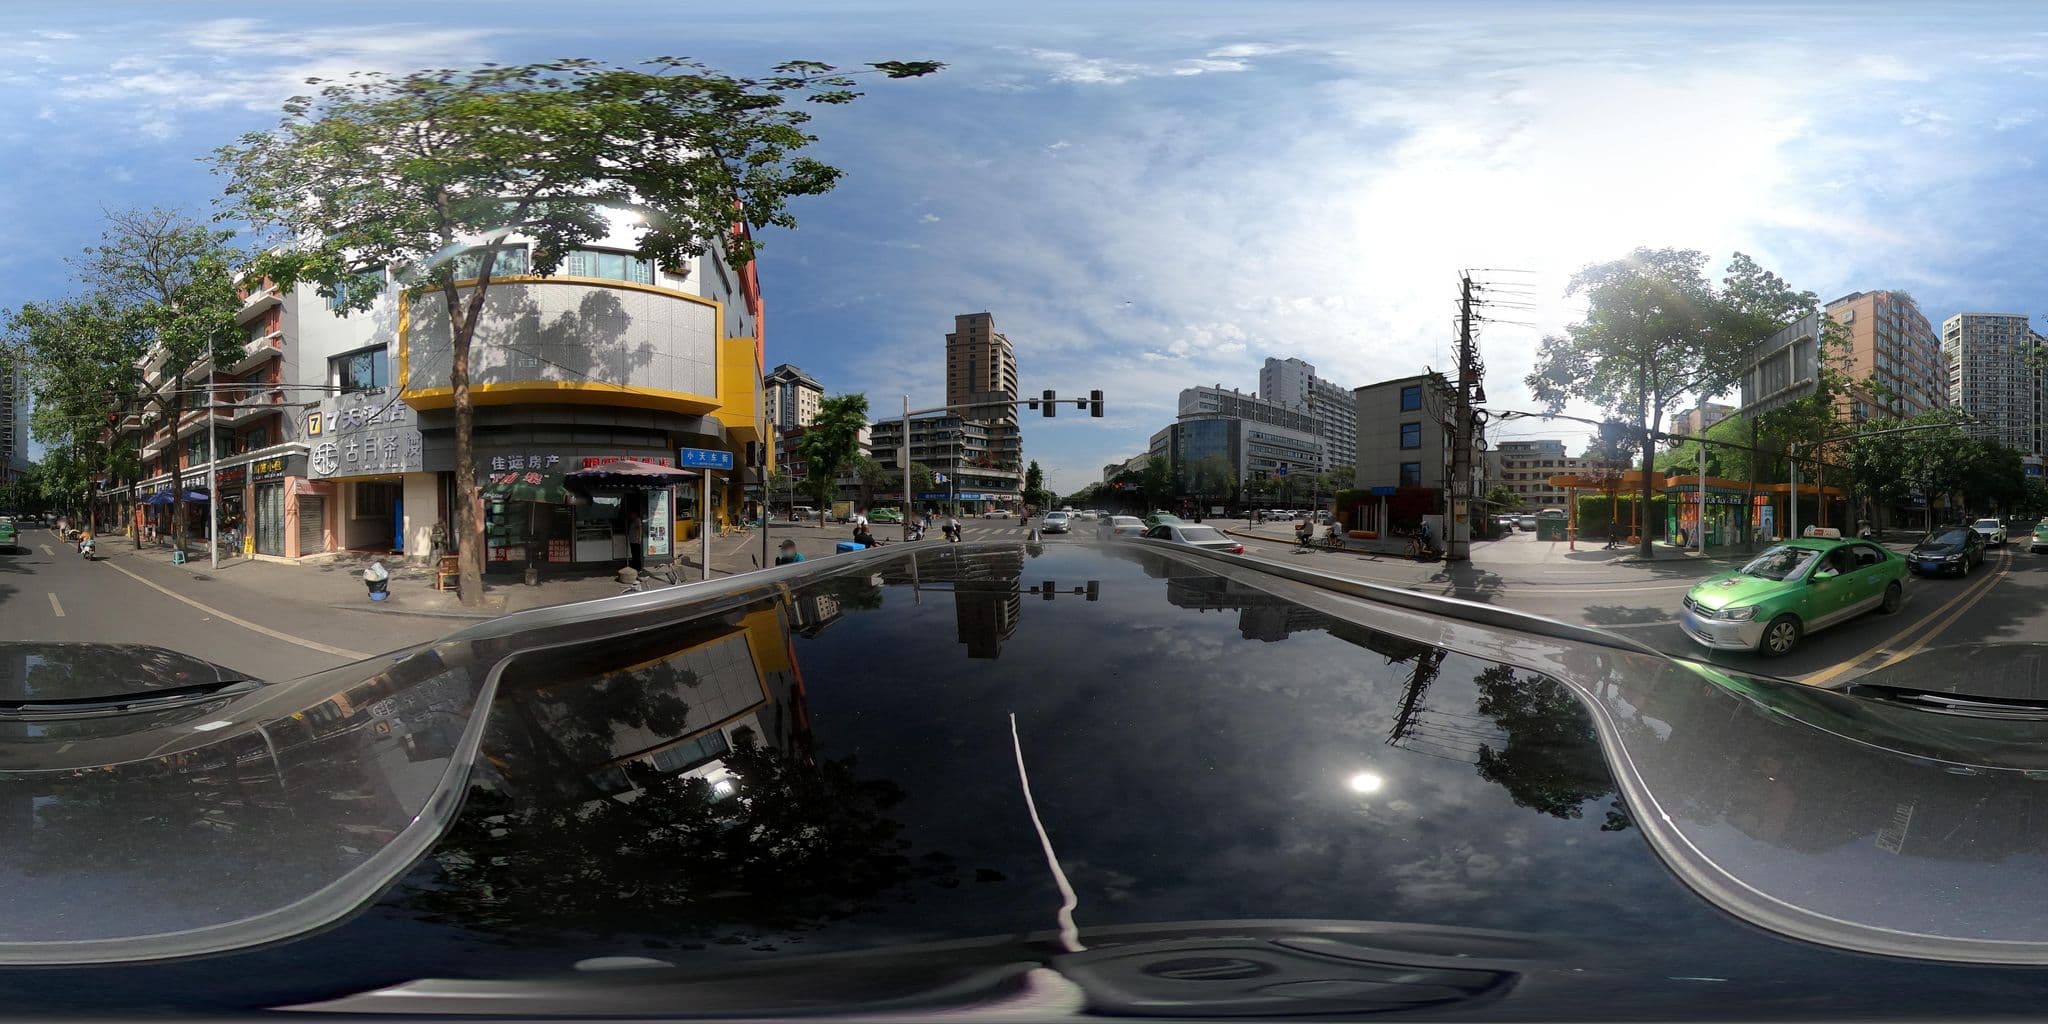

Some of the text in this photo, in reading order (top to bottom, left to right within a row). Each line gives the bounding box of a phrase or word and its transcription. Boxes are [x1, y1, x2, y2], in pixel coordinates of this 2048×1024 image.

[310, 417, 319, 431] 7
[326, 402, 407, 432] 7天酒店
[345, 432, 421, 462] 古月茶楼
[491, 454, 559, 470] 佳运房产
